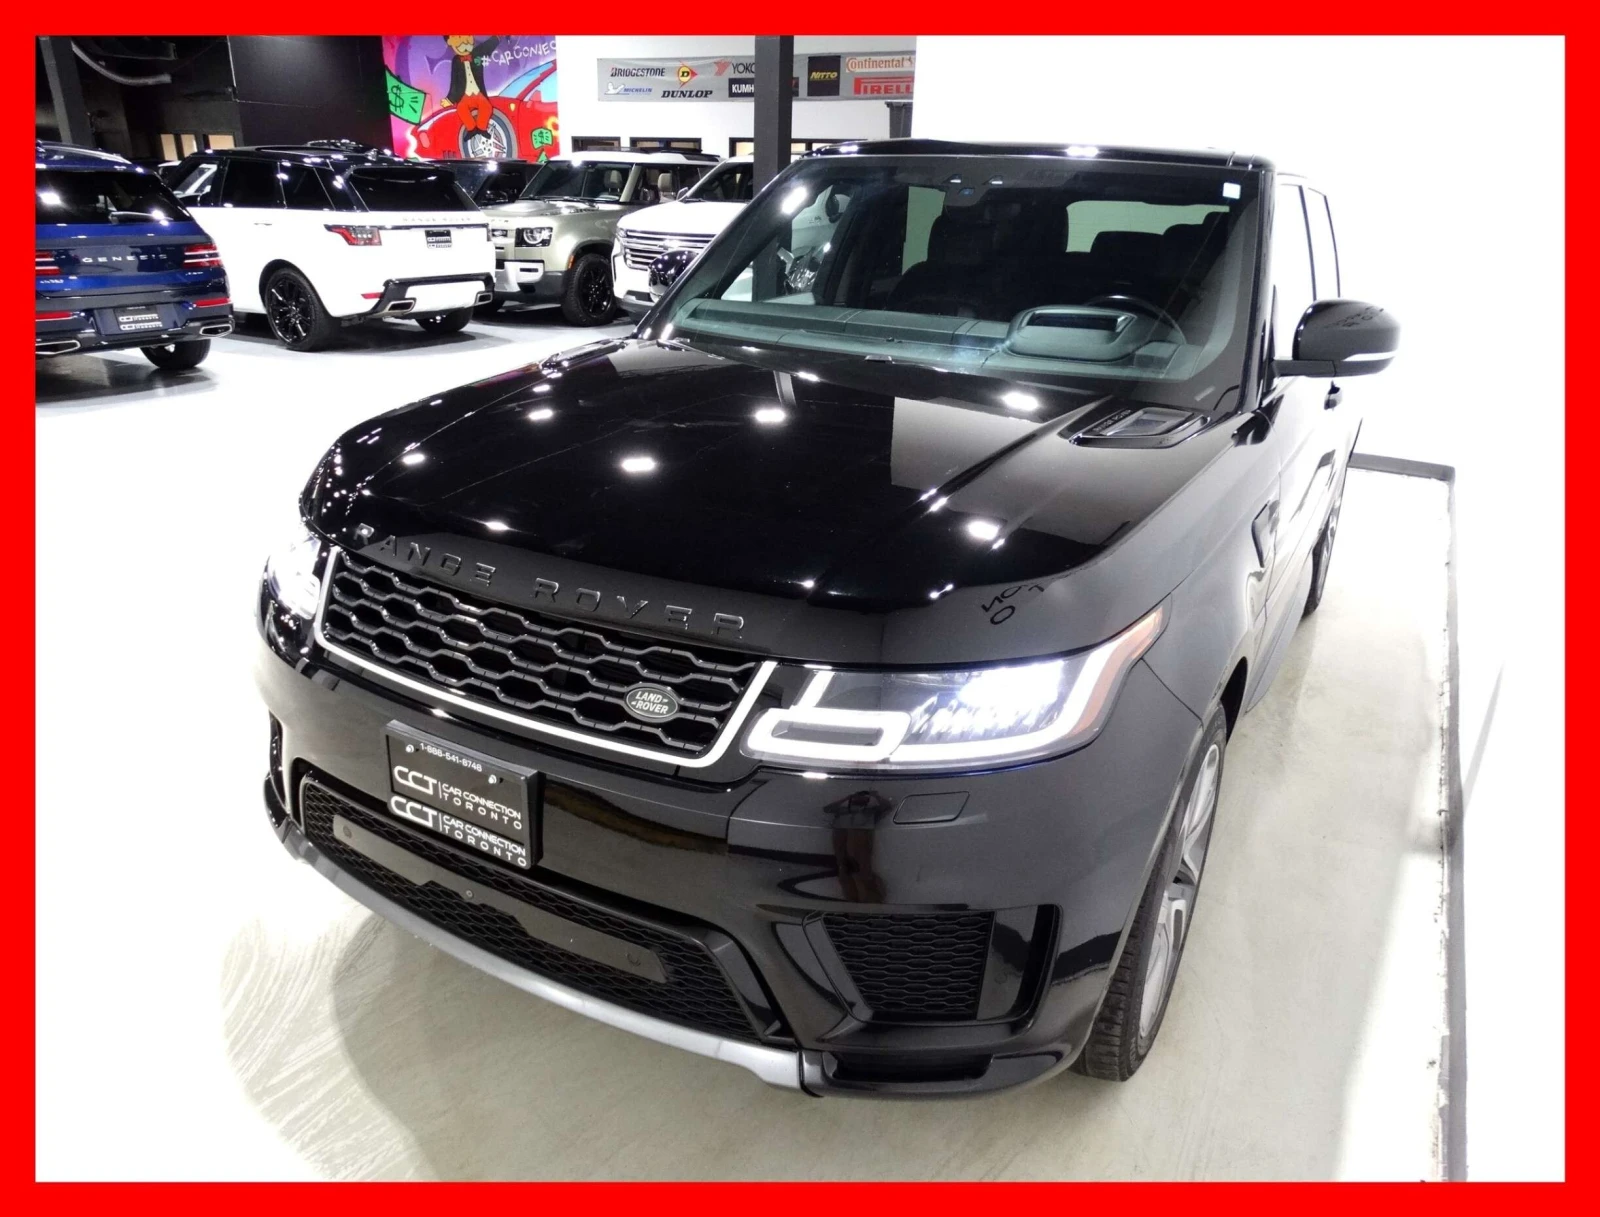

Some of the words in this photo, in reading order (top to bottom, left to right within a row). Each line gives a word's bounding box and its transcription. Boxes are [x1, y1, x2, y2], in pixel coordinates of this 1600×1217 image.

[847, 56, 905, 72] Continental
[610, 67, 665, 77] BRIDGESTONE
[810, 71, 838, 80] NITTO
[661, 90, 713, 98] DUNLOP
[82, 253, 168, 263] GENESIS
[354, 523, 496, 587] RANGE
[532, 577, 745, 640] ROVER
[635, 690, 663, 703] LAND
[635, 701, 669, 715] ROVER
[394, 765, 437, 795] CCT
[442, 783, 462, 797] CAR
[463, 792, 521, 820] CONNECTION
[443, 792, 522, 830] TORONTO
[390, 796, 437, 828] CCT
[443, 815, 464, 830] CAR
[465, 824, 526, 857] CONNECTION
[444, 825, 527, 867] TORONTO
